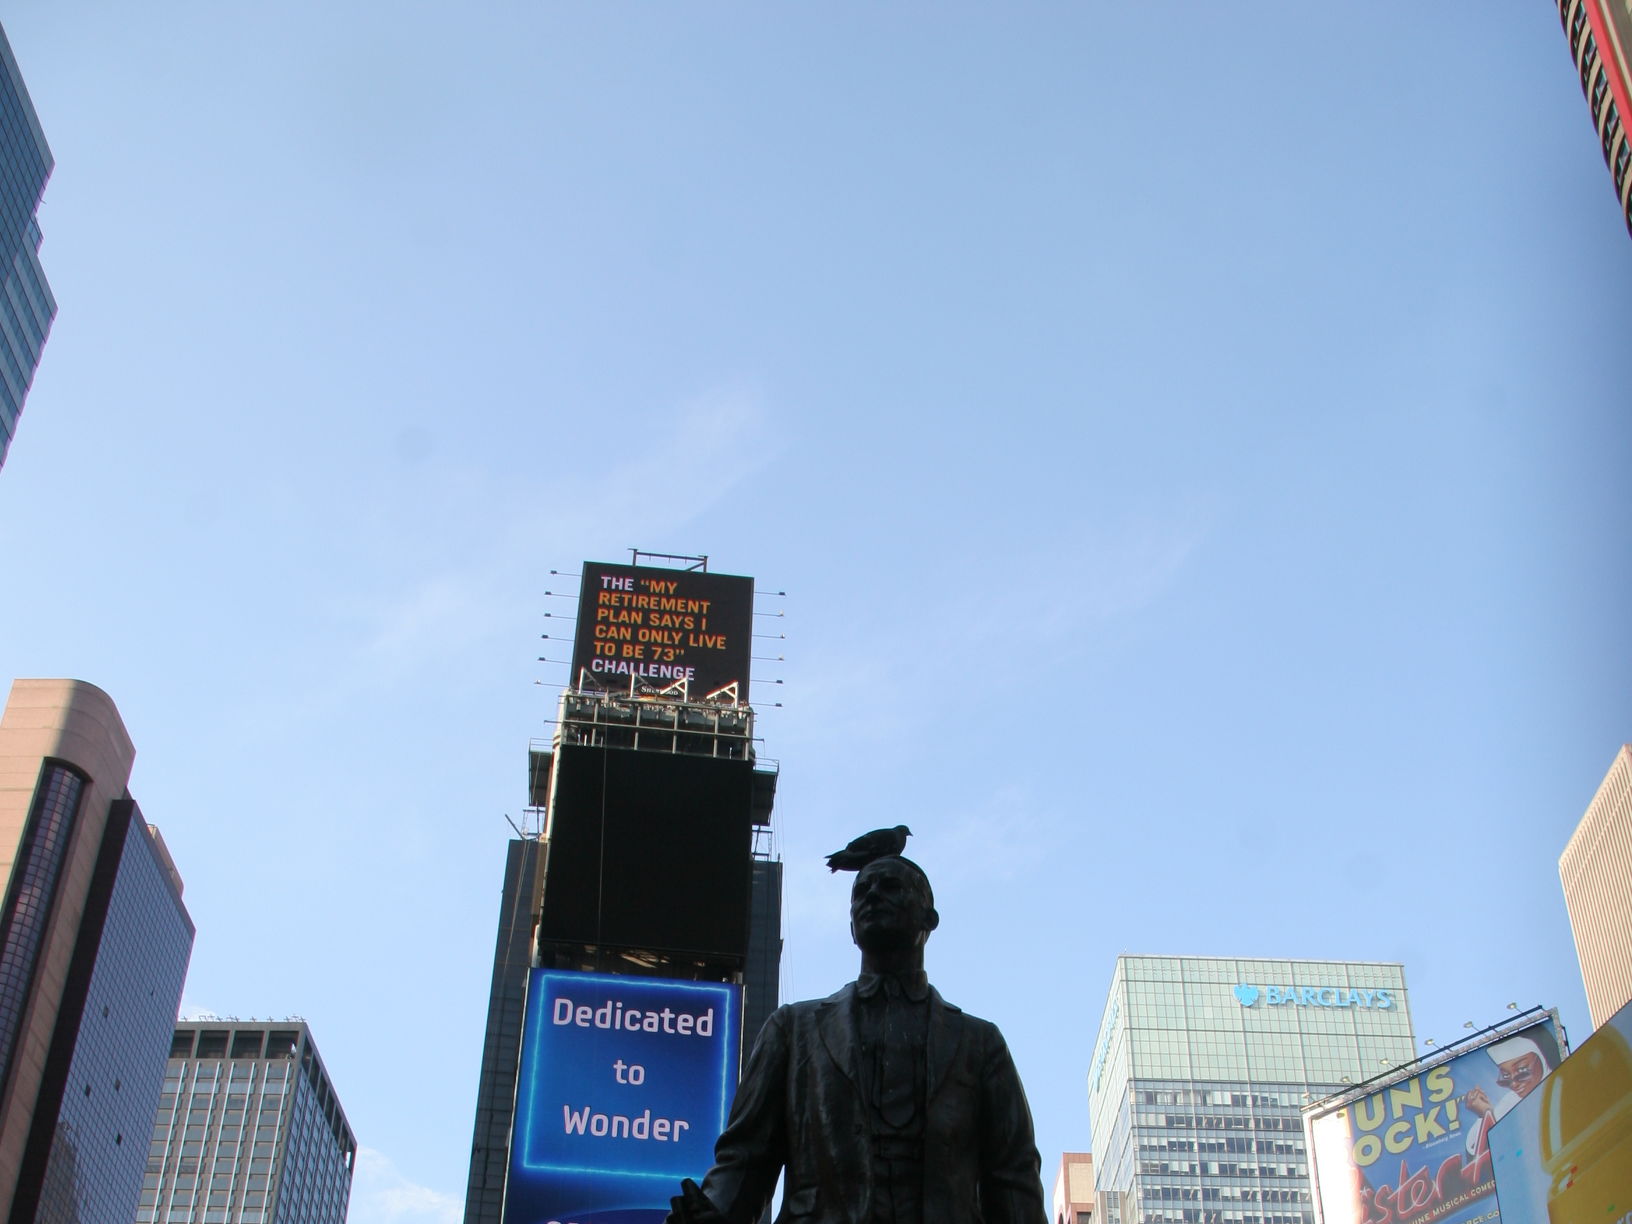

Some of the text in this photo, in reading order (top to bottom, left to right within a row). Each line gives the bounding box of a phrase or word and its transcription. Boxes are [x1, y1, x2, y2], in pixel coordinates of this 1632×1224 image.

[601, 576, 634, 591] THE
[598, 591, 711, 614] RETIREMENT
[597, 608, 706, 631] PLAN SAYS I
[595, 625, 727, 650] CAN ONLY LIVE
[594, 641, 616, 656] TO
[622, 645, 644, 659] BE
[591, 659, 695, 681] CHALLENGE
[1266, 986, 1392, 1009] BARCLAYS
[553, 998, 714, 1037] Dedicated
[613, 1059, 645, 1086] to
[1355, 1066, 1454, 1131] UNS
[563, 1104, 690, 1142] Wonder
[1353, 1097, 1466, 1166] OCK!”
[1432, 1194, 1469, 1216] MUSICAL
